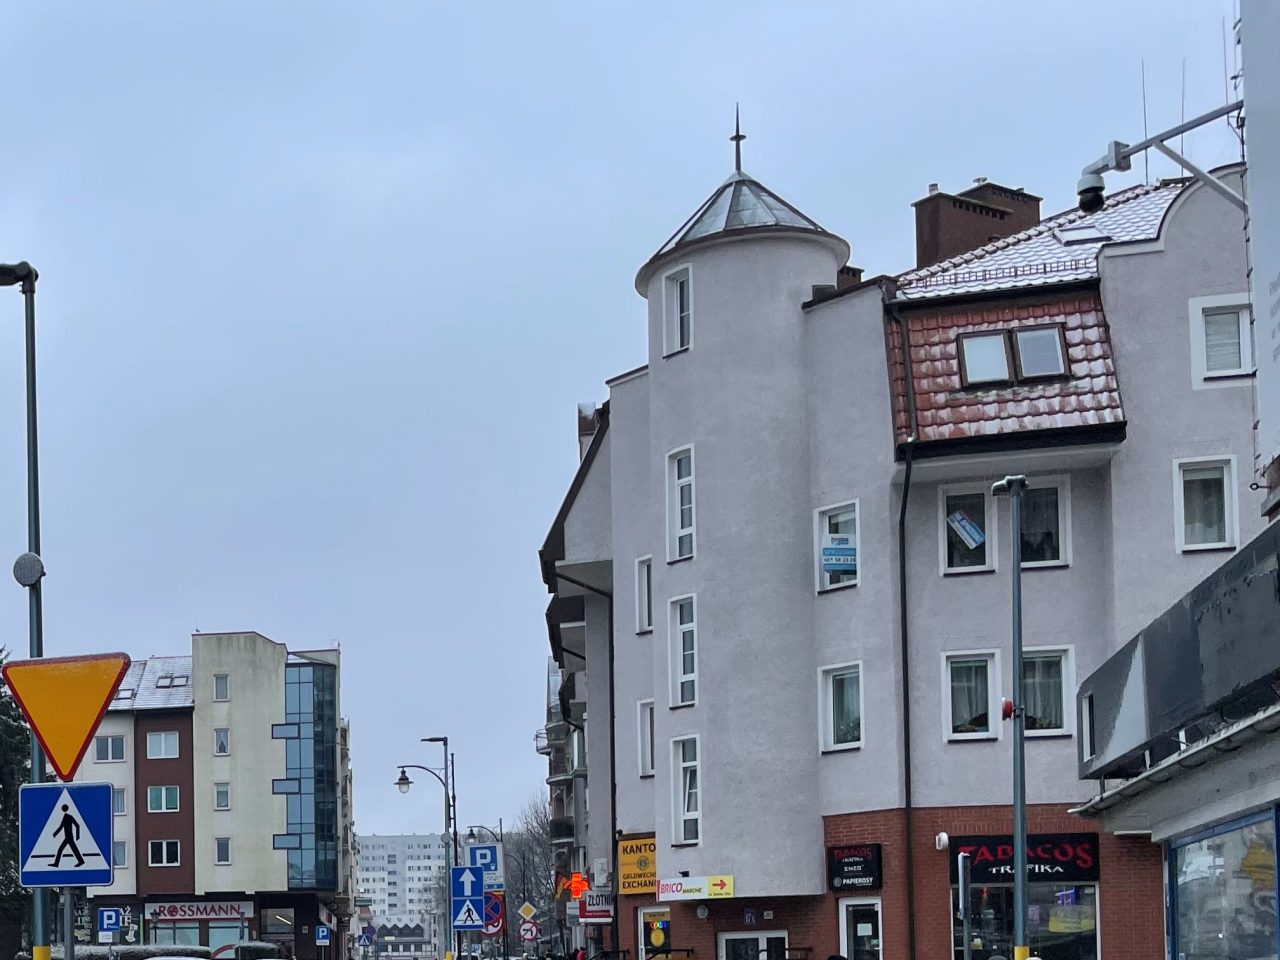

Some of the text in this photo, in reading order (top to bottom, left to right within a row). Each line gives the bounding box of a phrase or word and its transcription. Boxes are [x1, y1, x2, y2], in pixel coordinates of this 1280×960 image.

[623, 843, 656, 854] KANTO
[988, 864, 1064, 873] TRFIKA
[623, 880, 656, 889] EXCHAN
[661, 883, 683, 893] BRICO
[158, 904, 241, 917] ROSSMANN
[103, 911, 116, 929] P
